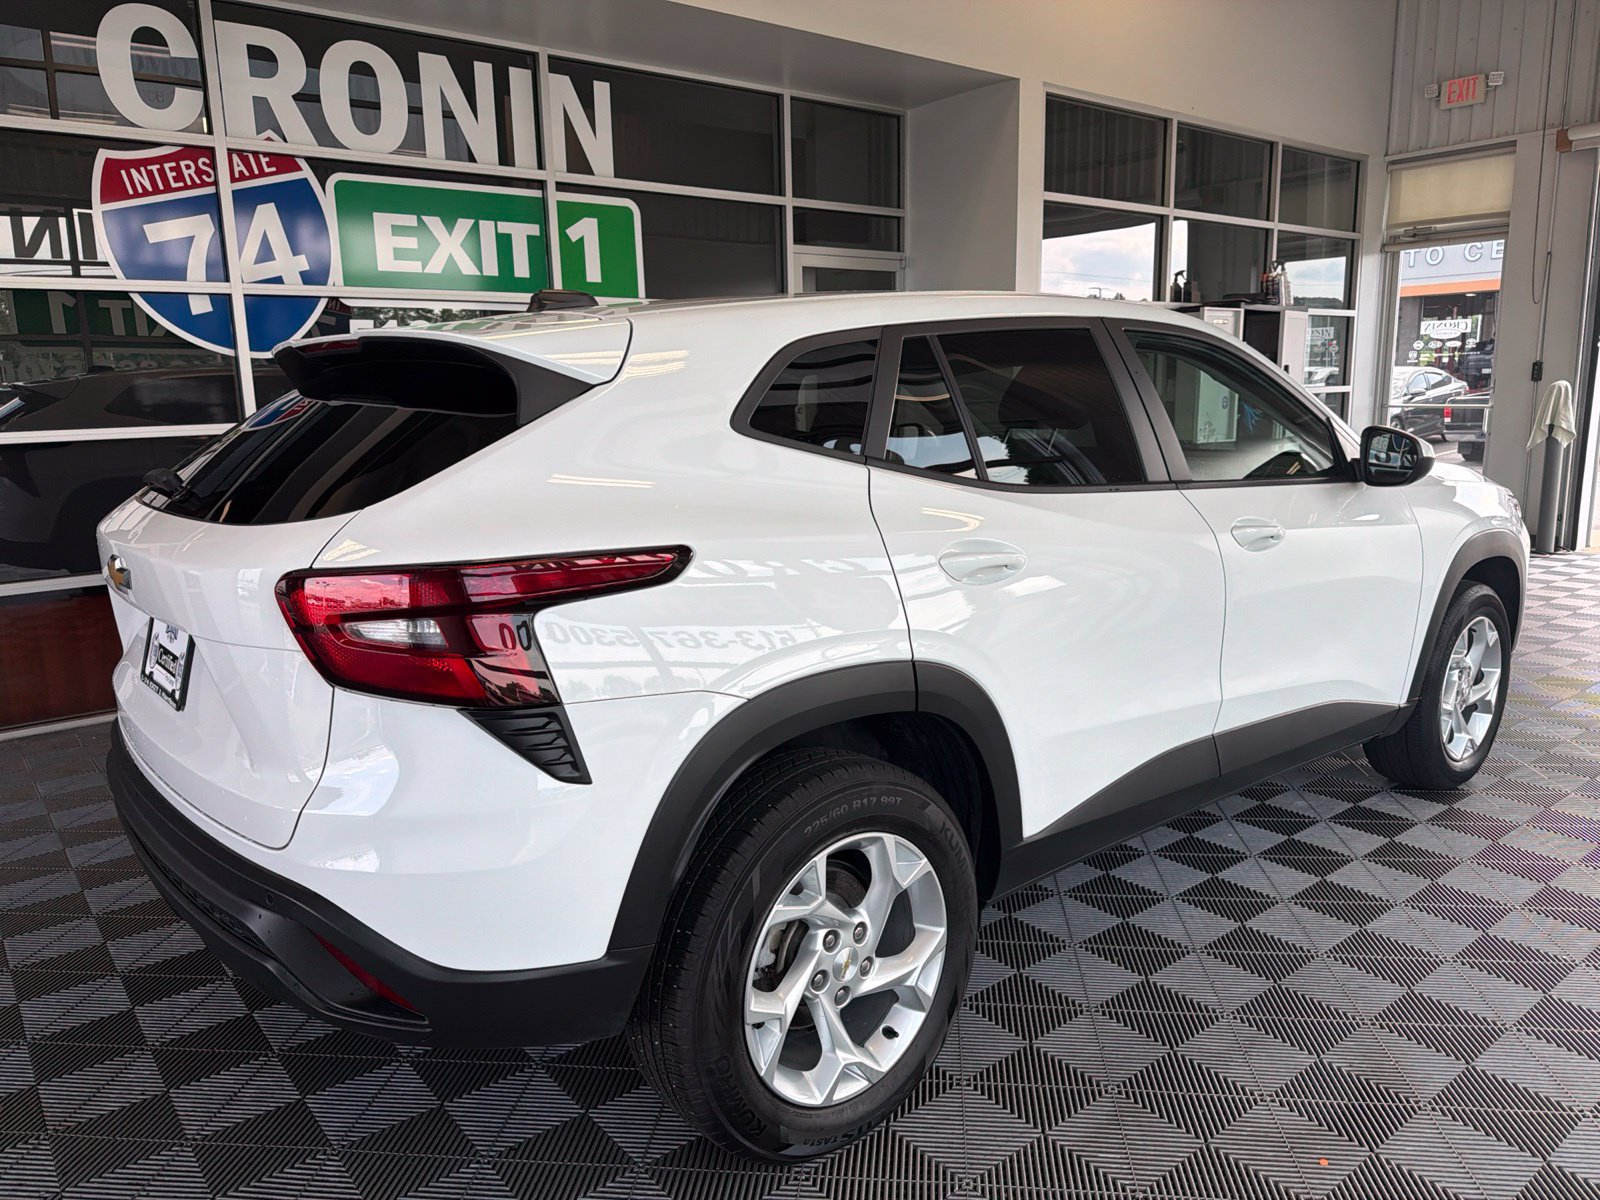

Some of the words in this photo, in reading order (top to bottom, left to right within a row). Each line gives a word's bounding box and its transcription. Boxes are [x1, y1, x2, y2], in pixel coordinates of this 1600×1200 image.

[96, 3, 615, 178] CRONIN
[1447, 76, 1479, 104] EXIT
[120, 152, 277, 195] INTERSATE
[143, 202, 311, 316] 74
[373, 212, 541, 279] EXIT
[565, 217, 602, 283] 1
[1405, 246, 1444, 268] TO
[1464, 241, 1504, 262] CE
[804, 805, 848, 837] 225/60
[852, 797, 877, 809] R17
[880, 796, 902, 807] 99T
